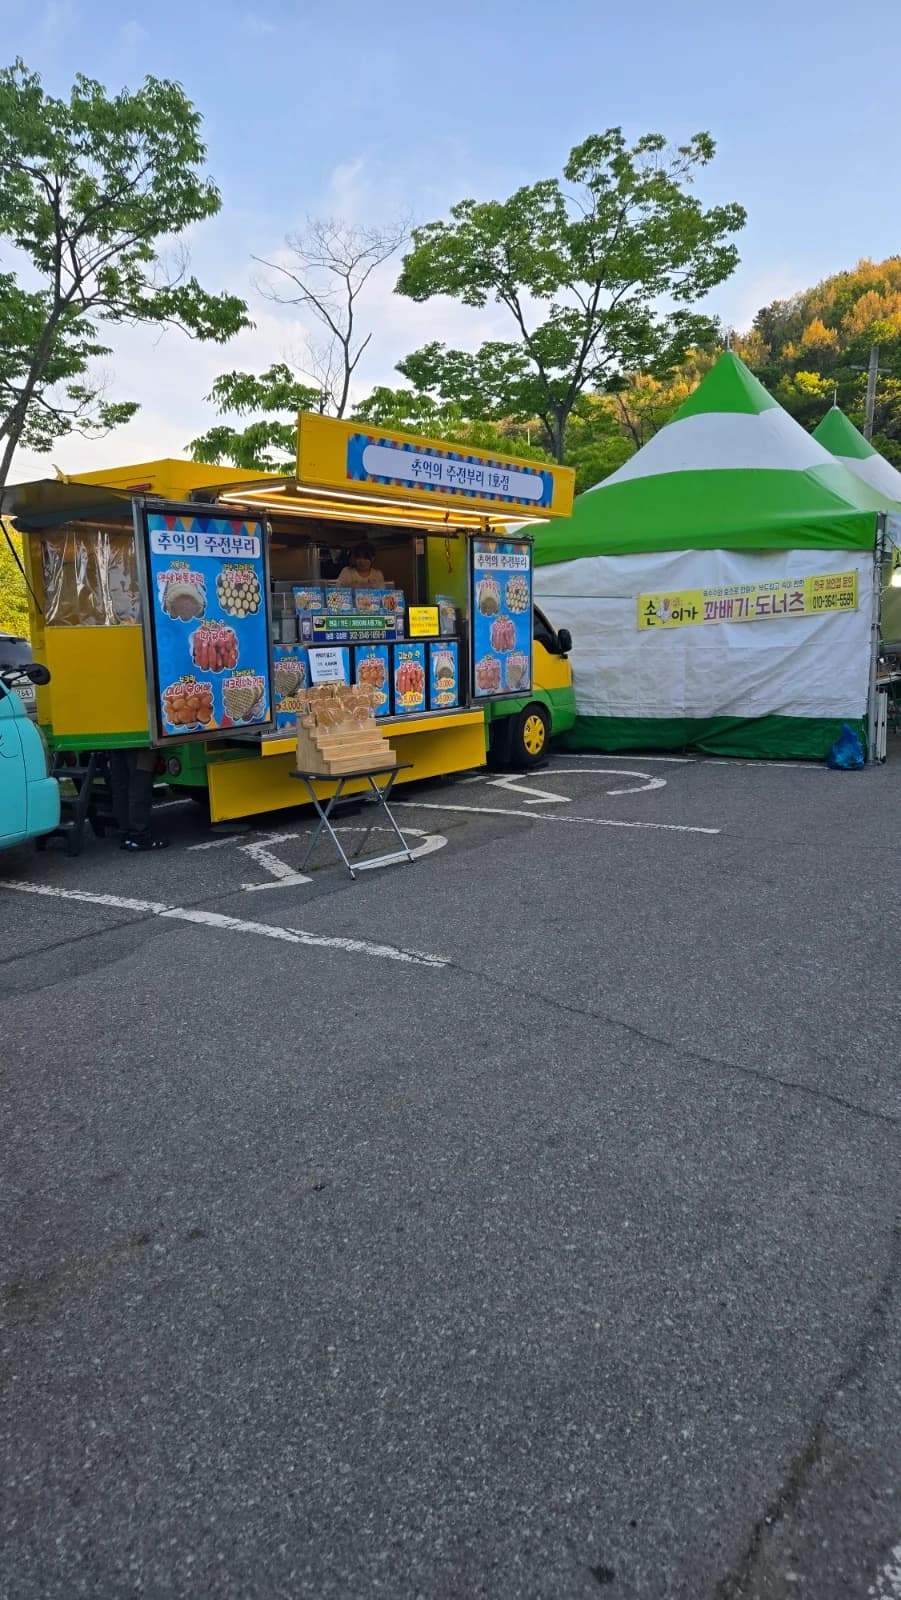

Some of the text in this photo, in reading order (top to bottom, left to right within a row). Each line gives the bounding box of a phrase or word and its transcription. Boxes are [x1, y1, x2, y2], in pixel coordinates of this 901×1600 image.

[411, 459, 510, 492] 추억의 주전부리 1호점
[158, 533, 255, 555] 추억의 주전부리
[477, 554, 527, 569] 추억의 주전부리
